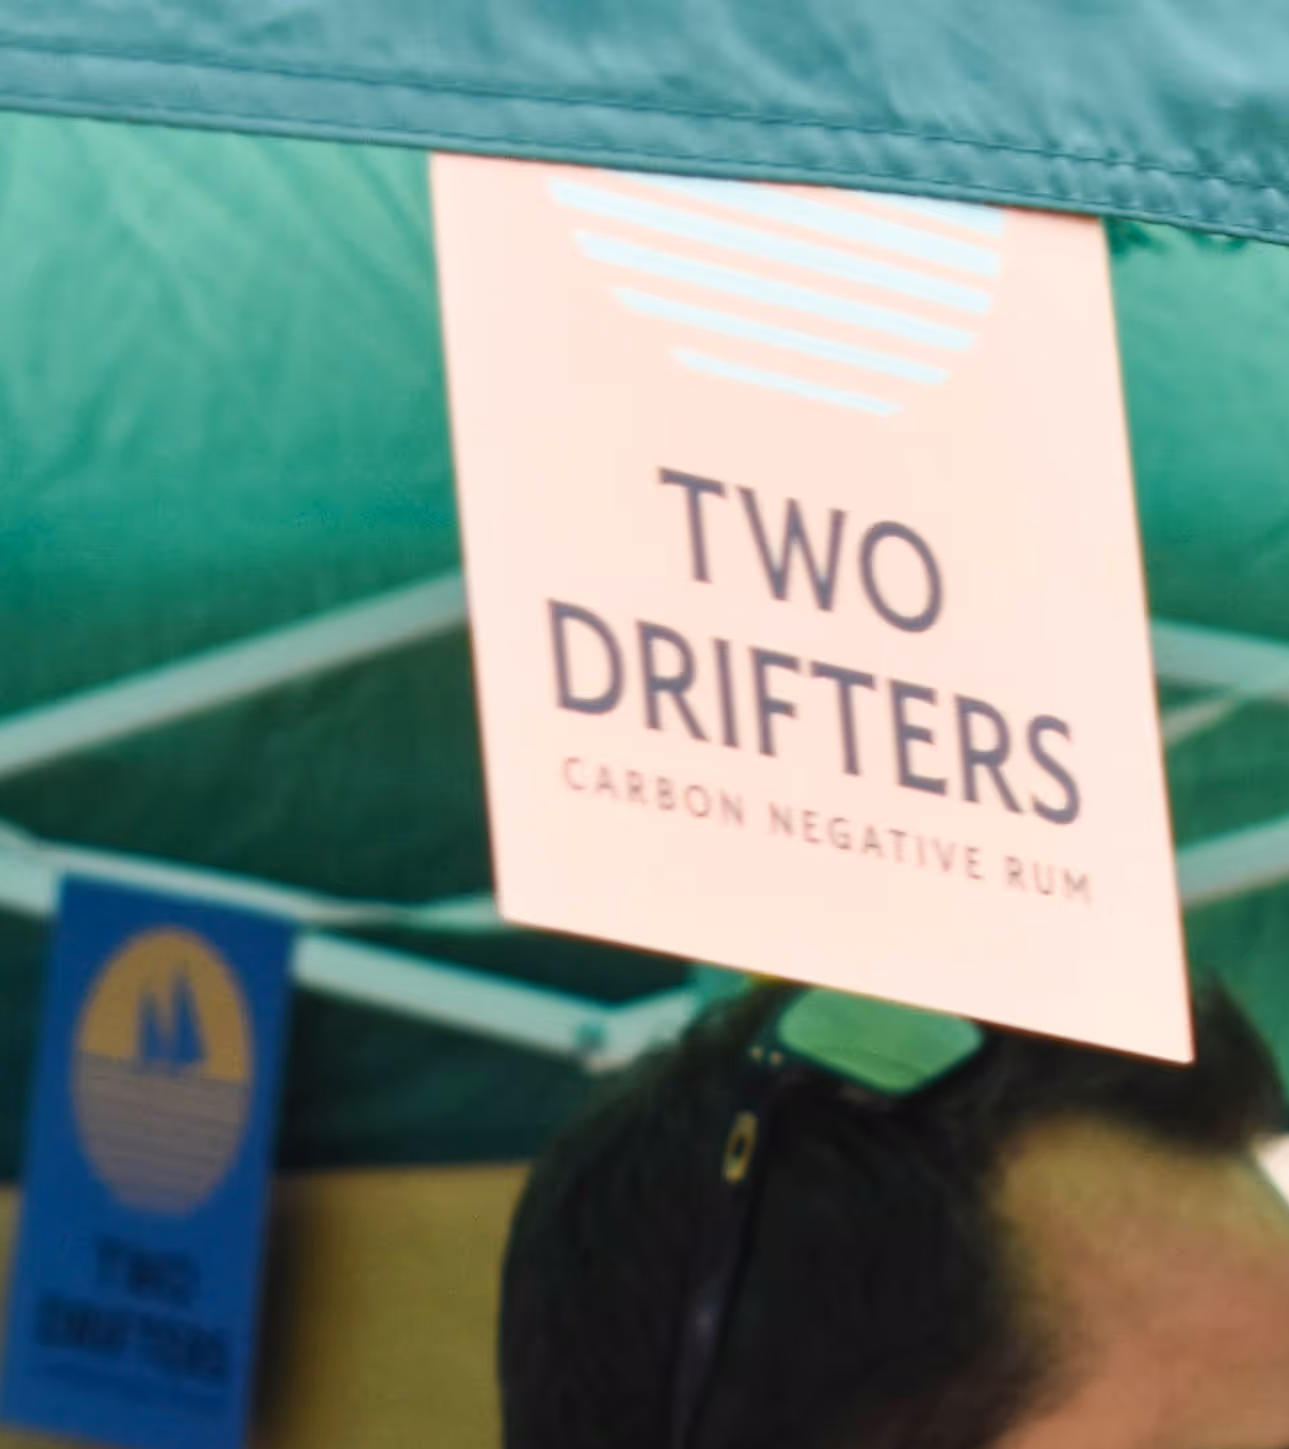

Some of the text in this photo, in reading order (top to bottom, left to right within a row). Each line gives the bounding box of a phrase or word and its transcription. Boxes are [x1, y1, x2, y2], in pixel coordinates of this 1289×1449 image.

[659, 466, 943, 634] TWO
[550, 600, 1082, 826] DRIFTERS
[562, 755, 1093, 905] CARBON NEGATIVE RUM
